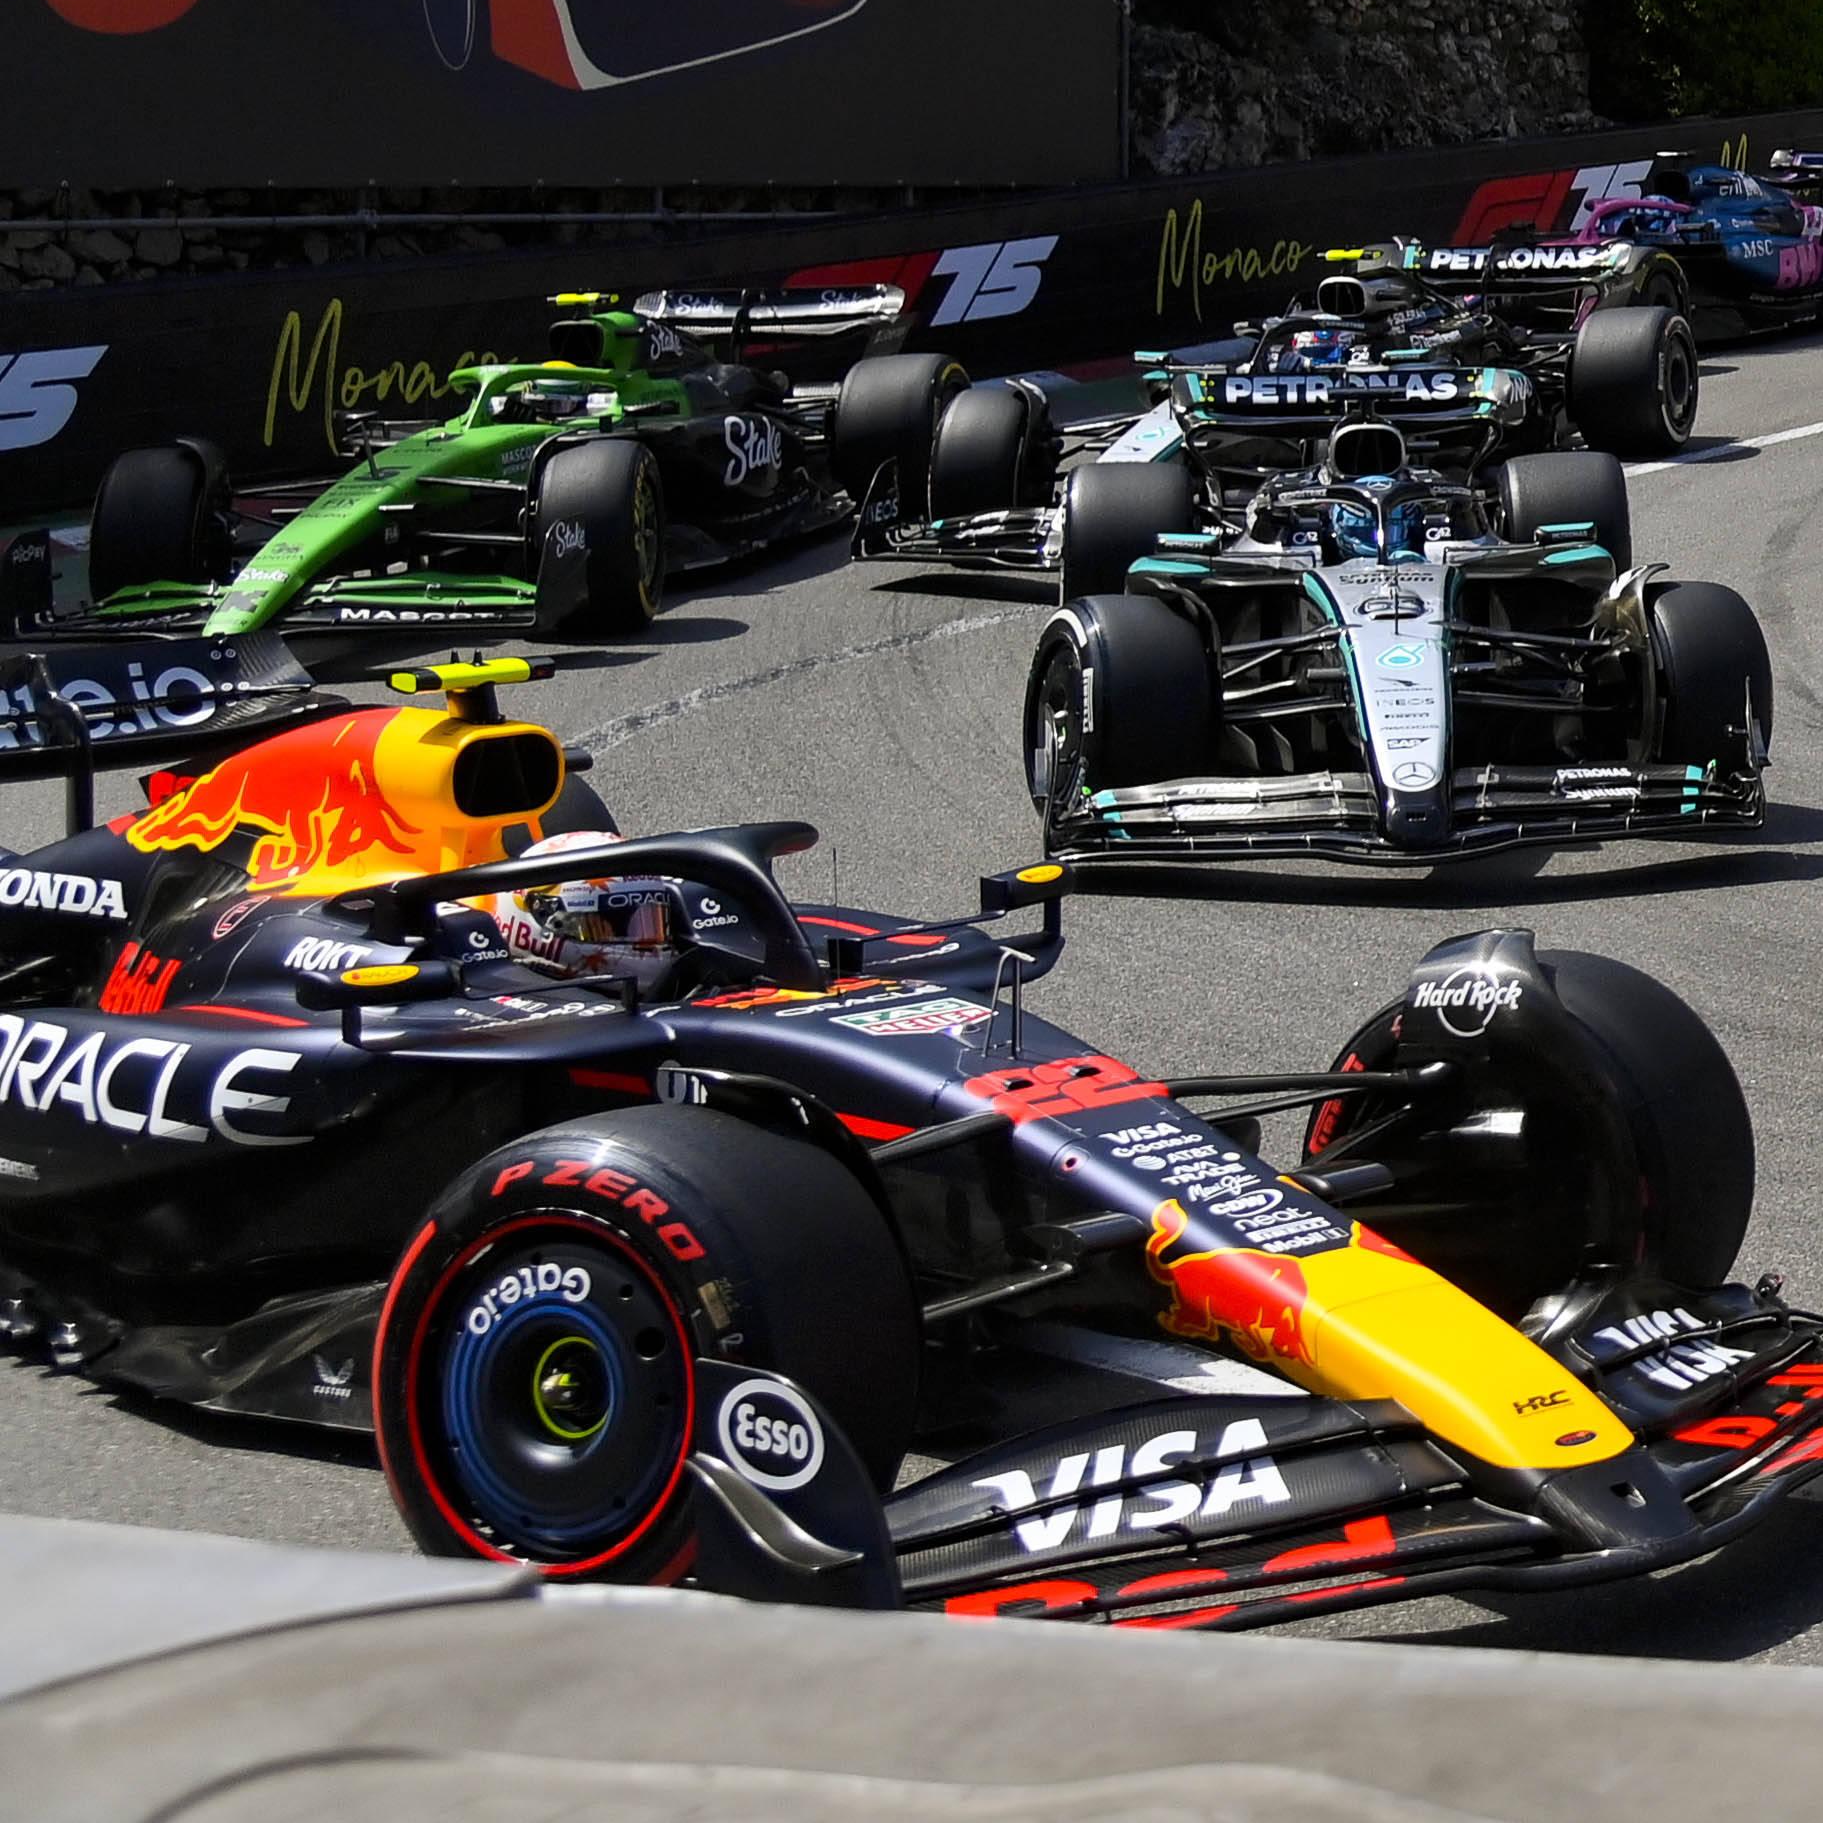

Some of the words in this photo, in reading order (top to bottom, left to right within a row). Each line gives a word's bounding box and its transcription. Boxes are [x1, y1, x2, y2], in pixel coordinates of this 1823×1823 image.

[1570, 160, 1654, 231] 75
[1155, 199, 1311, 322] Monaco
[1430, 246, 1600, 270] PETONAS
[1743, 239, 1775, 261] MSC
[930, 235, 1060, 327] 75
[647, 320, 684, 361] Stake
[501, 444, 537, 467] MASCO
[724, 415, 783, 487] Stake
[554, 519, 586, 558] Stake
[1556, 766, 1632, 780] PETRONAS
[0, 868, 127, 919] ONDA
[693, 913, 739, 929] Gate.io
[284, 936, 375, 972] ROKT
[845, 999, 968, 1025] TAG
[1413, 980, 1470, 1008] Hard
[1469, 979, 1523, 1012] Rock
[1099, 1122, 1182, 1145] VISA
[1165, 1144, 1219, 1165] AT&T
[491, 1161, 535, 1197] P
[542, 1160, 708, 1262] ZERO
[1209, 1192, 1269, 1217] CDW
[1262, 1231, 1324, 1253] Mobil
[468, 1262, 592, 1336] Gate.io
[971, 1417, 1291, 1553] VISA
